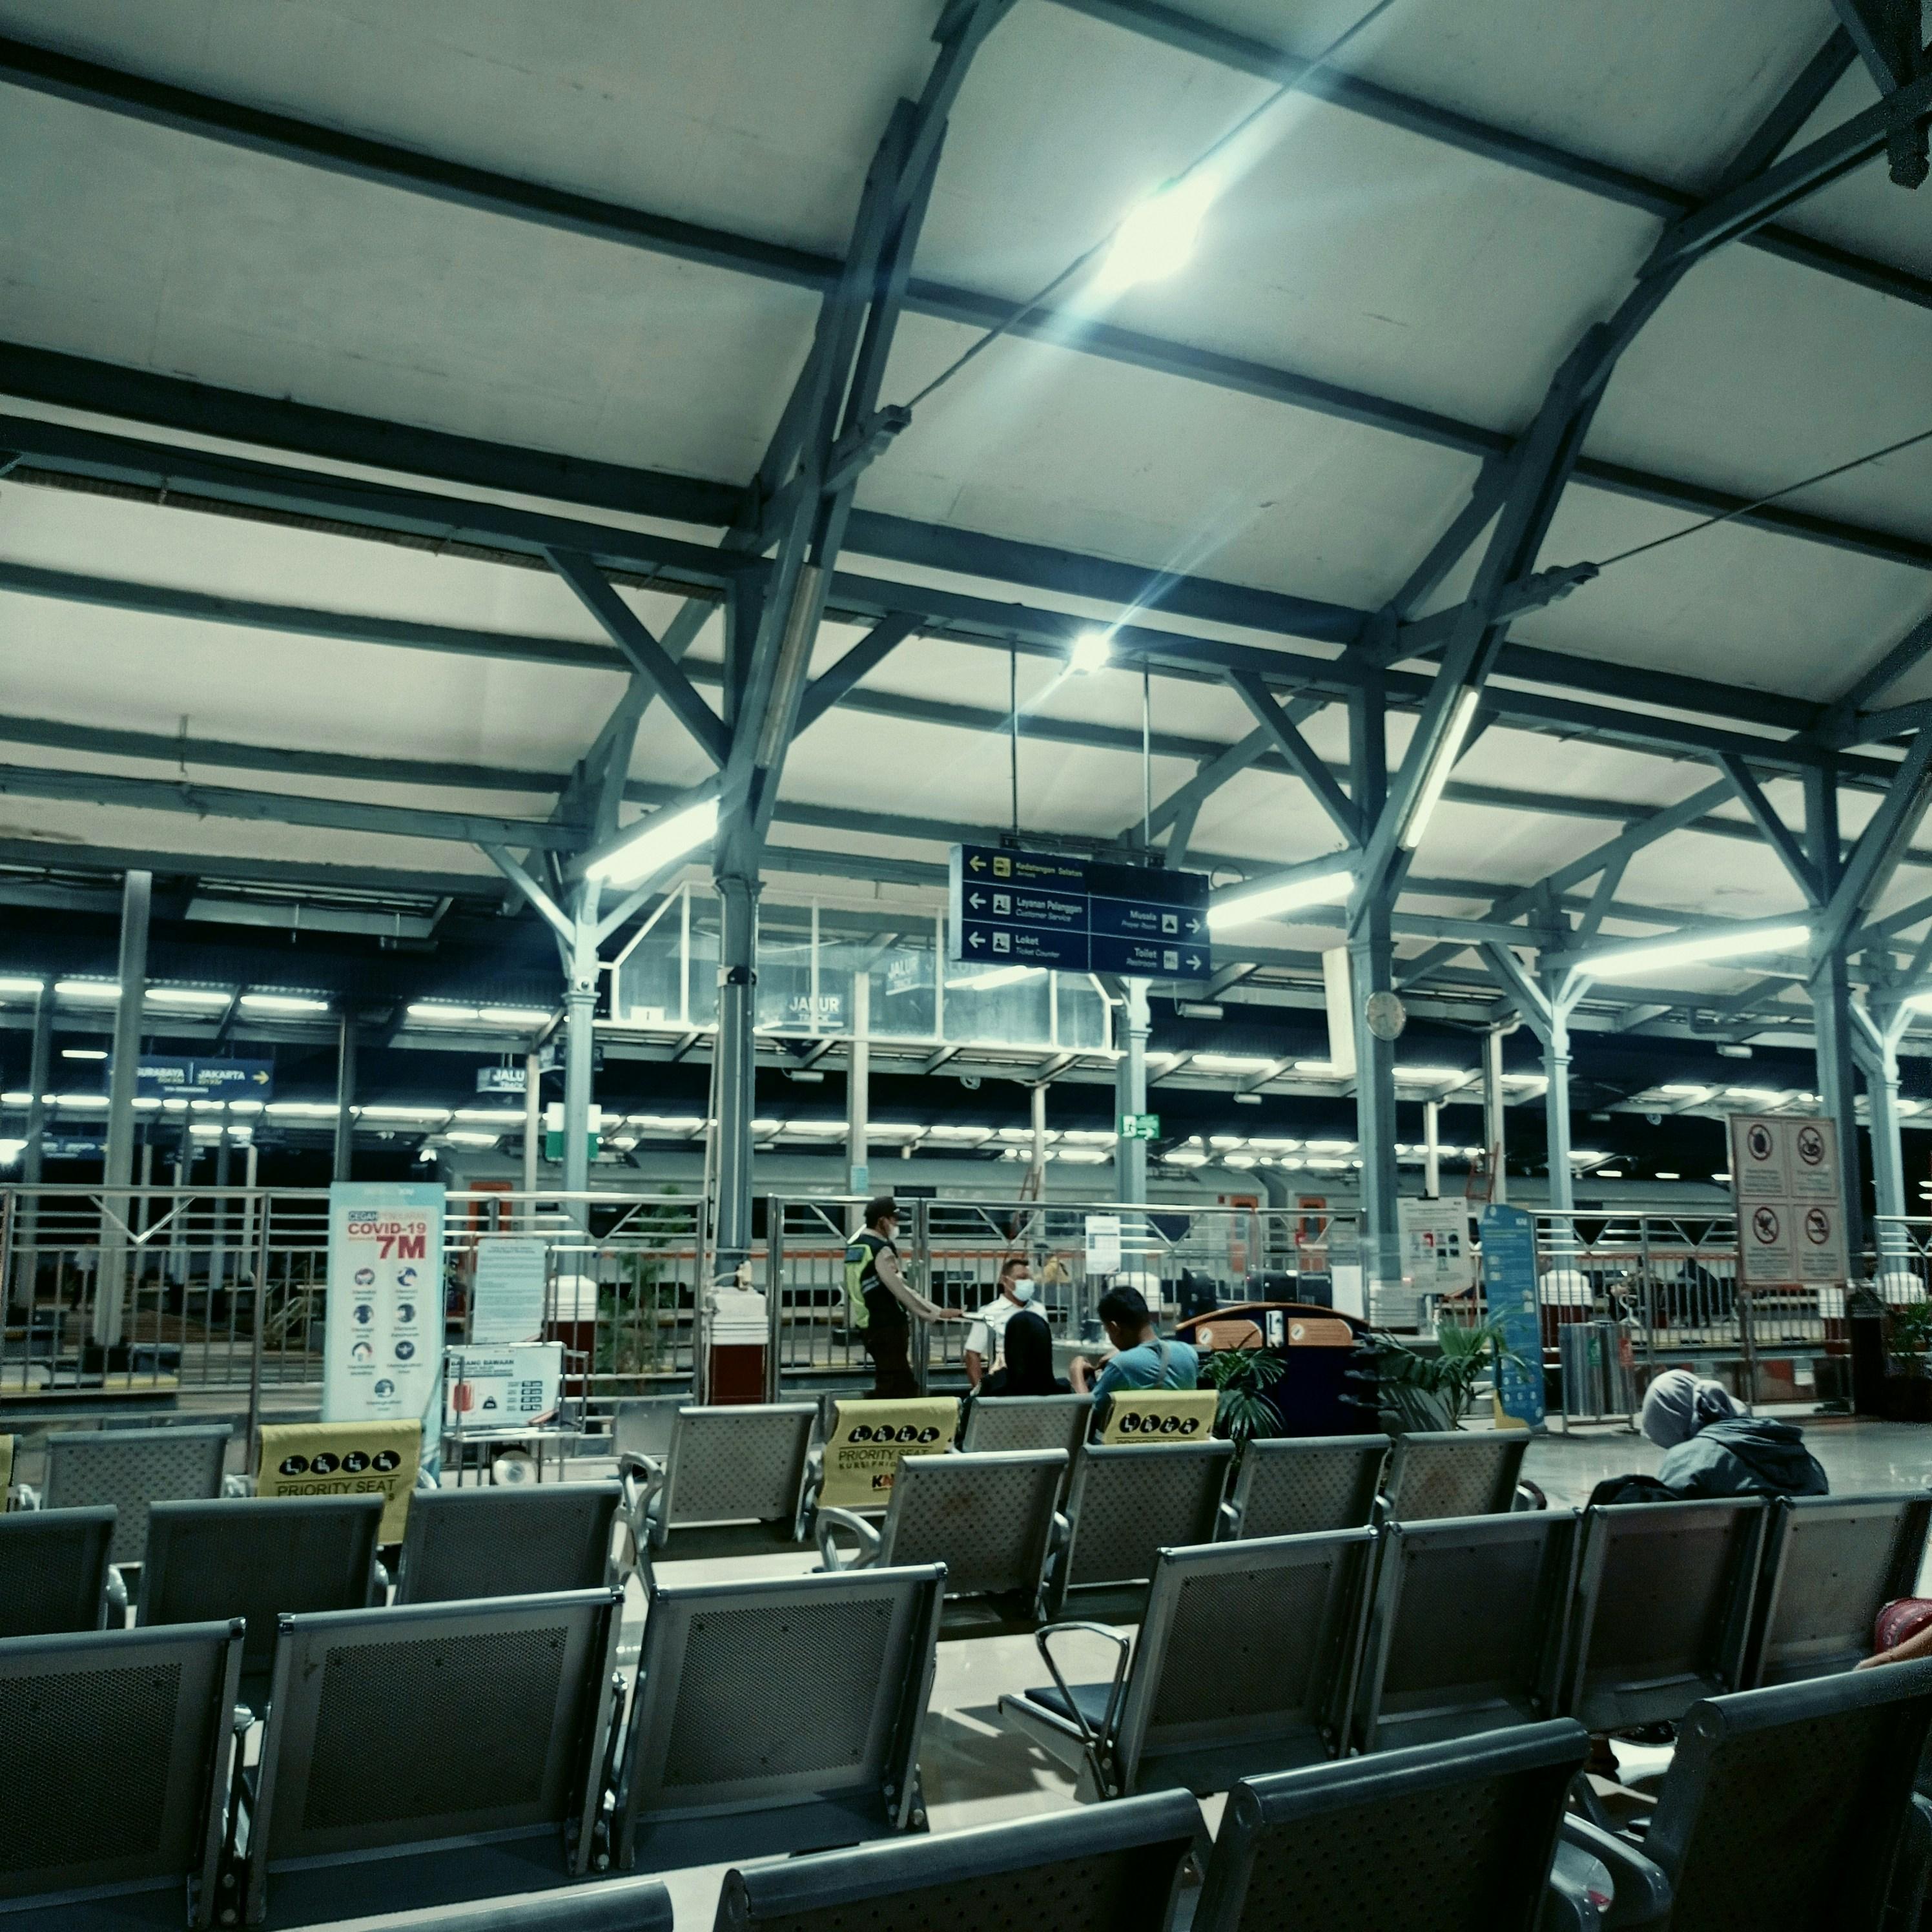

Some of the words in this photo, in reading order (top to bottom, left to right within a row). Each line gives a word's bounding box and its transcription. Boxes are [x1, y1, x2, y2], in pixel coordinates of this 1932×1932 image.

[1015, 935, 1039, 945] Loket
[1134, 947, 1157, 958] Toilet
[136, 1067, 185, 1078] URABAYA
[198, 1069, 245, 1081] JAKARTA
[492, 1069, 526, 1082] JALU
[349, 1212, 377, 1220] CEGAH
[348, 1222, 427, 1235] COVID-19
[376, 1235, 426, 1259] 7M
[839, 1449, 896, 1461] PRIORITY
[277, 1481, 352, 1497] PRIORITY
[356, 1479, 396, 1494] SEAT
